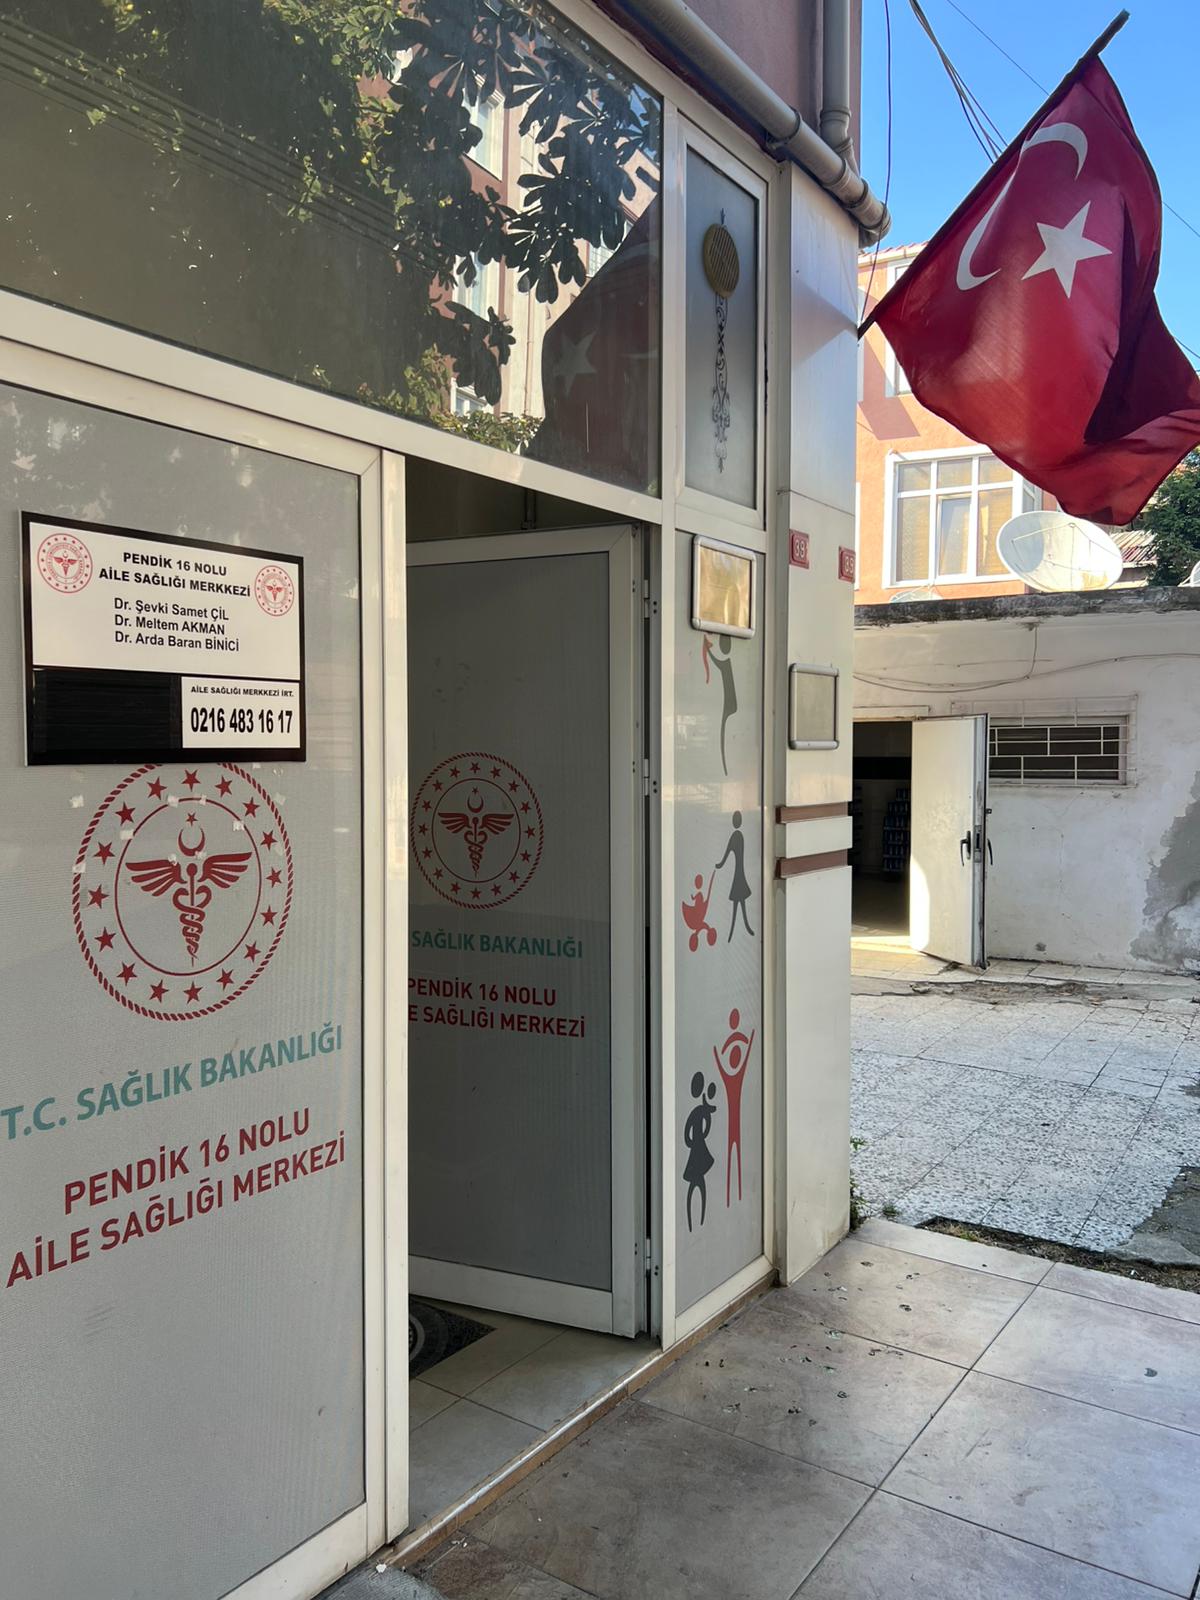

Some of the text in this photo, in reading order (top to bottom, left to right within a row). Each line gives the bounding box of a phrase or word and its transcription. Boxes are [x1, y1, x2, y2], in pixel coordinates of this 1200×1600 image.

[123, 552, 227, 576] PENDİK 16 NOLU
[99, 567, 129, 581] AİLE
[134, 573, 185, 588] SAĞLIĞI
[190, 580, 250, 597] MERKKEZİ
[115, 598, 229, 621] Dr. Şevki Samet ÇİL
[115, 614, 224, 635] Dr. Meltem AKMAN
[115, 631, 239, 651] Dr. Arda Baran BİNİCİ
[191, 685, 208, 693] AİLE
[211, 686, 240, 694] SAĞLIĞI
[191, 707, 292, 733] 0216 483 16 17
[412, 928, 582, 958] SAĞLIK BAKANLIĞI
[408, 977, 556, 1006] PENDİK 16 NOLU
[424, 1004, 494, 1029] SAĞLIĞI
[500, 1013, 585, 1038] MERKEZİ
[1, 1022, 342, 1140] T.C. SAĞLIK BAKANLIĞI
[65, 1107, 309, 1215] PENDİK 16 NOLU
[6, 1130, 345, 1288] AİLE SAĞLIĞI MERKEZİ
